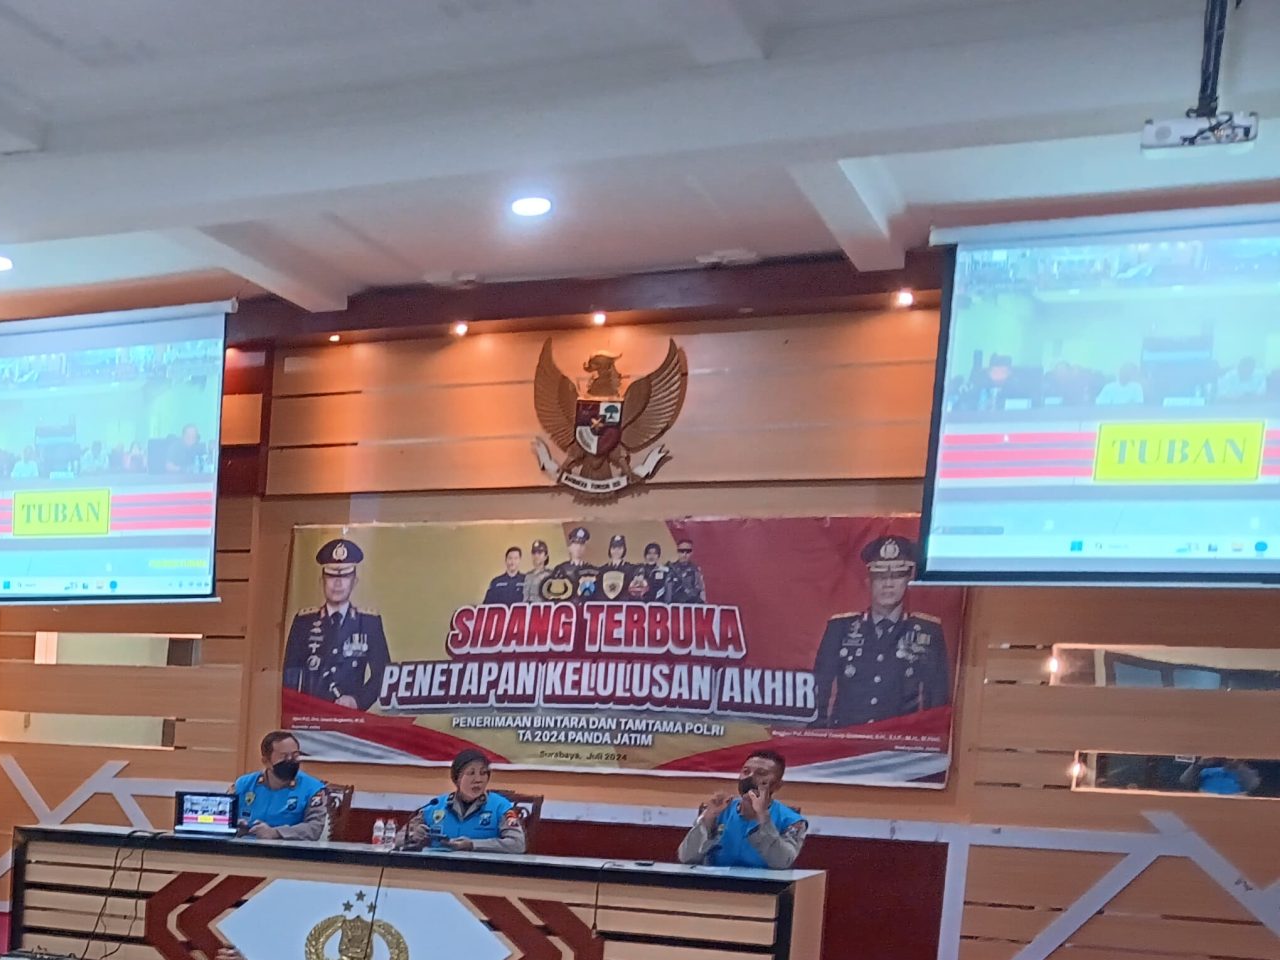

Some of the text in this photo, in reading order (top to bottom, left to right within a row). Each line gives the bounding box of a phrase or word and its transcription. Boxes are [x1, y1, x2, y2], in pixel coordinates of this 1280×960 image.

[1111, 437, 1247, 465] TUBAN
[21, 501, 101, 524] TUBAN
[448, 602, 744, 655] SIDANG TERBUKA
[380, 661, 816, 709] PENETAPAN KELULUSAN AKHIR
[452, 715, 725, 736] PENERIMAAN BINTARA DAN TAMTAMA POLRI
[518, 730, 653, 746] TA 2024 PANDA JATIM
[604, 753, 628, 761] 2024
